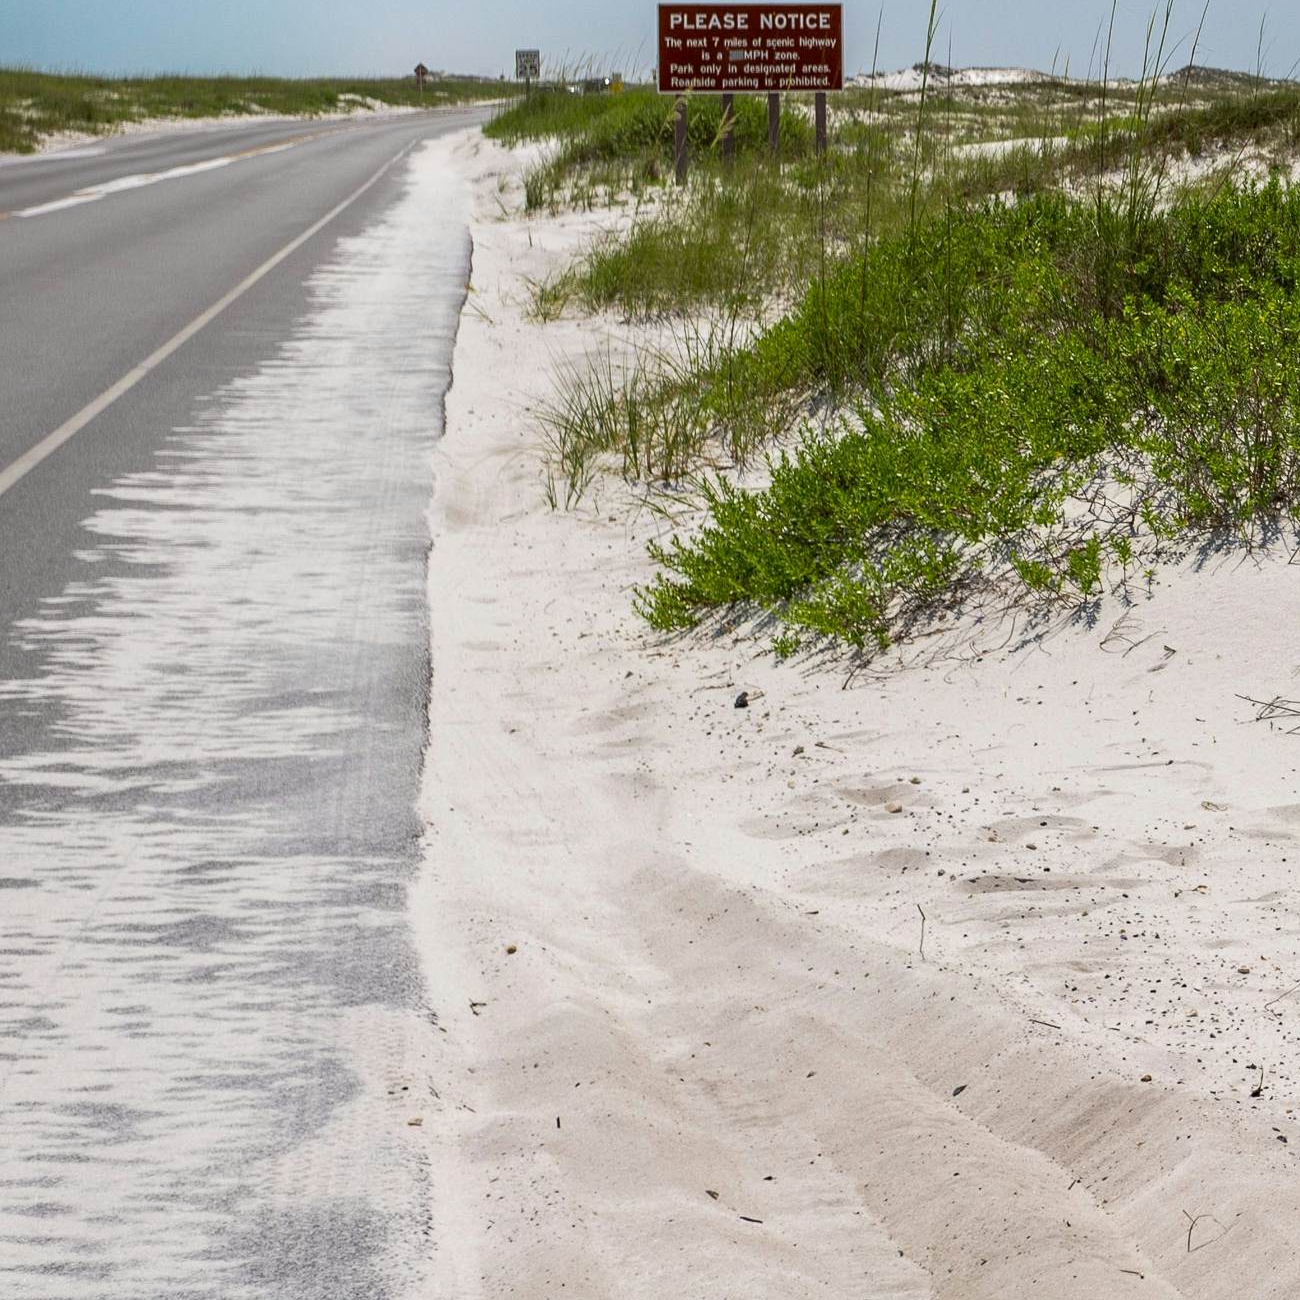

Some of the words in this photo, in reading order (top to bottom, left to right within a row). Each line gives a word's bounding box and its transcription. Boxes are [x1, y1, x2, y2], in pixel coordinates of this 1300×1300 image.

[670, 13, 749, 30] PLEASE
[760, 13, 832, 30] NOTICE
[665, 36, 683, 49] The
[686, 36, 708, 48] next
[712, 36, 720, 48] 7
[724, 37, 748, 48] miles
[752, 36, 762, 48] of
[766, 36, 795, 48] scenic
[799, 36, 837, 50] highway
[701, 50, 711, 61] is
[716, 52, 723, 61] a
[774, 51, 800, 61] zone.
[670, 63, 694, 75] Park
[700, 64, 722, 76] only
[728, 64, 738, 74] in
[743, 63, 796, 76] designated
[802, 64, 831, 74] areas.
[671, 77, 716, 88] Roadside
[722, 77, 759, 89] parking
[764, 77, 774, 87] is
[779, 76, 830, 89] prohibited.
